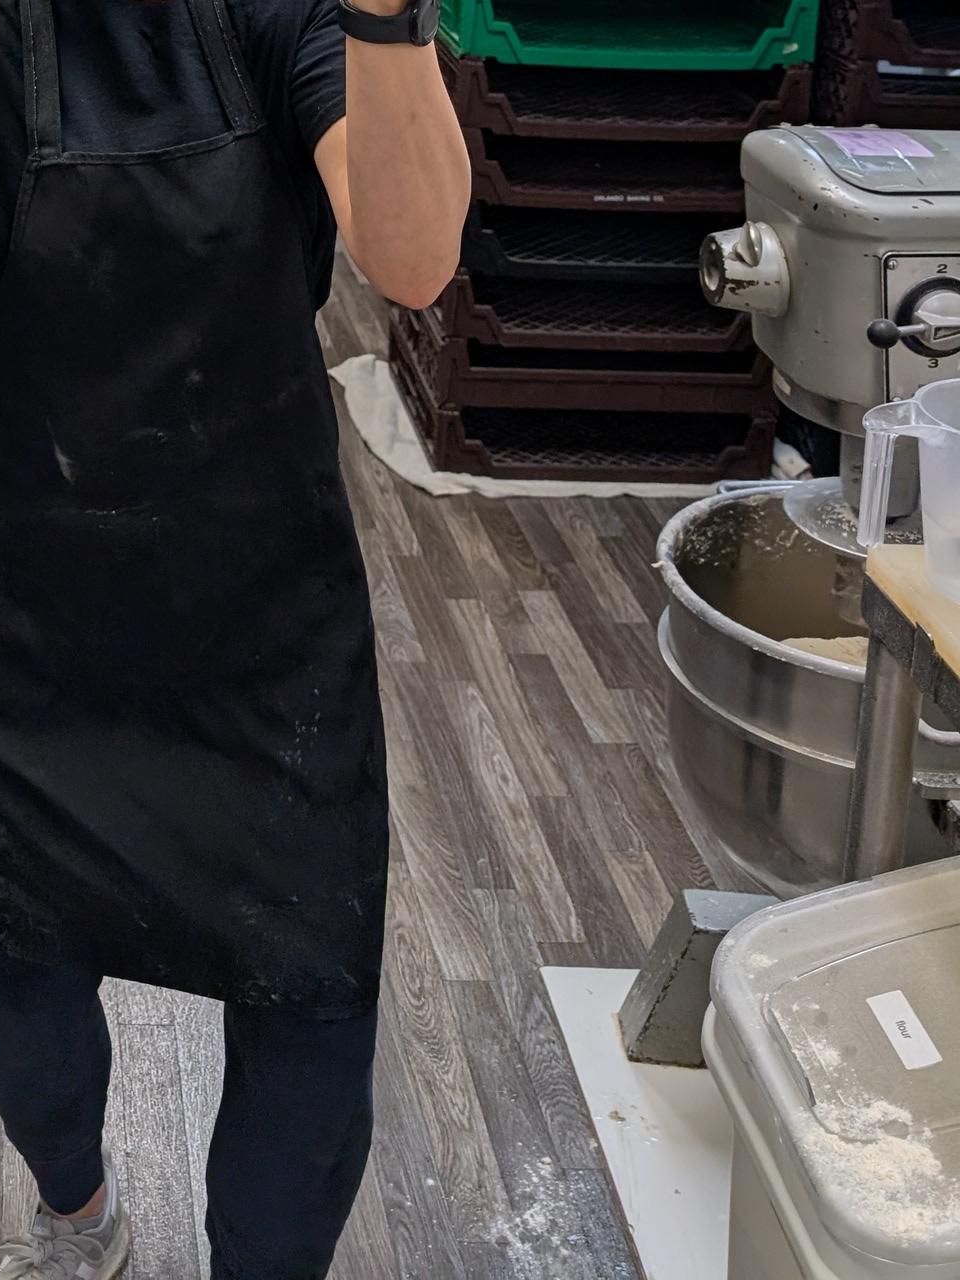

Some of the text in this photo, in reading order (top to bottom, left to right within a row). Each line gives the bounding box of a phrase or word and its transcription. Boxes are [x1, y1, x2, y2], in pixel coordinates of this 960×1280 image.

[936, 263, 948, 274] 2
[928, 358, 939, 369] 3
[895, 1020, 912, 1039] flour
